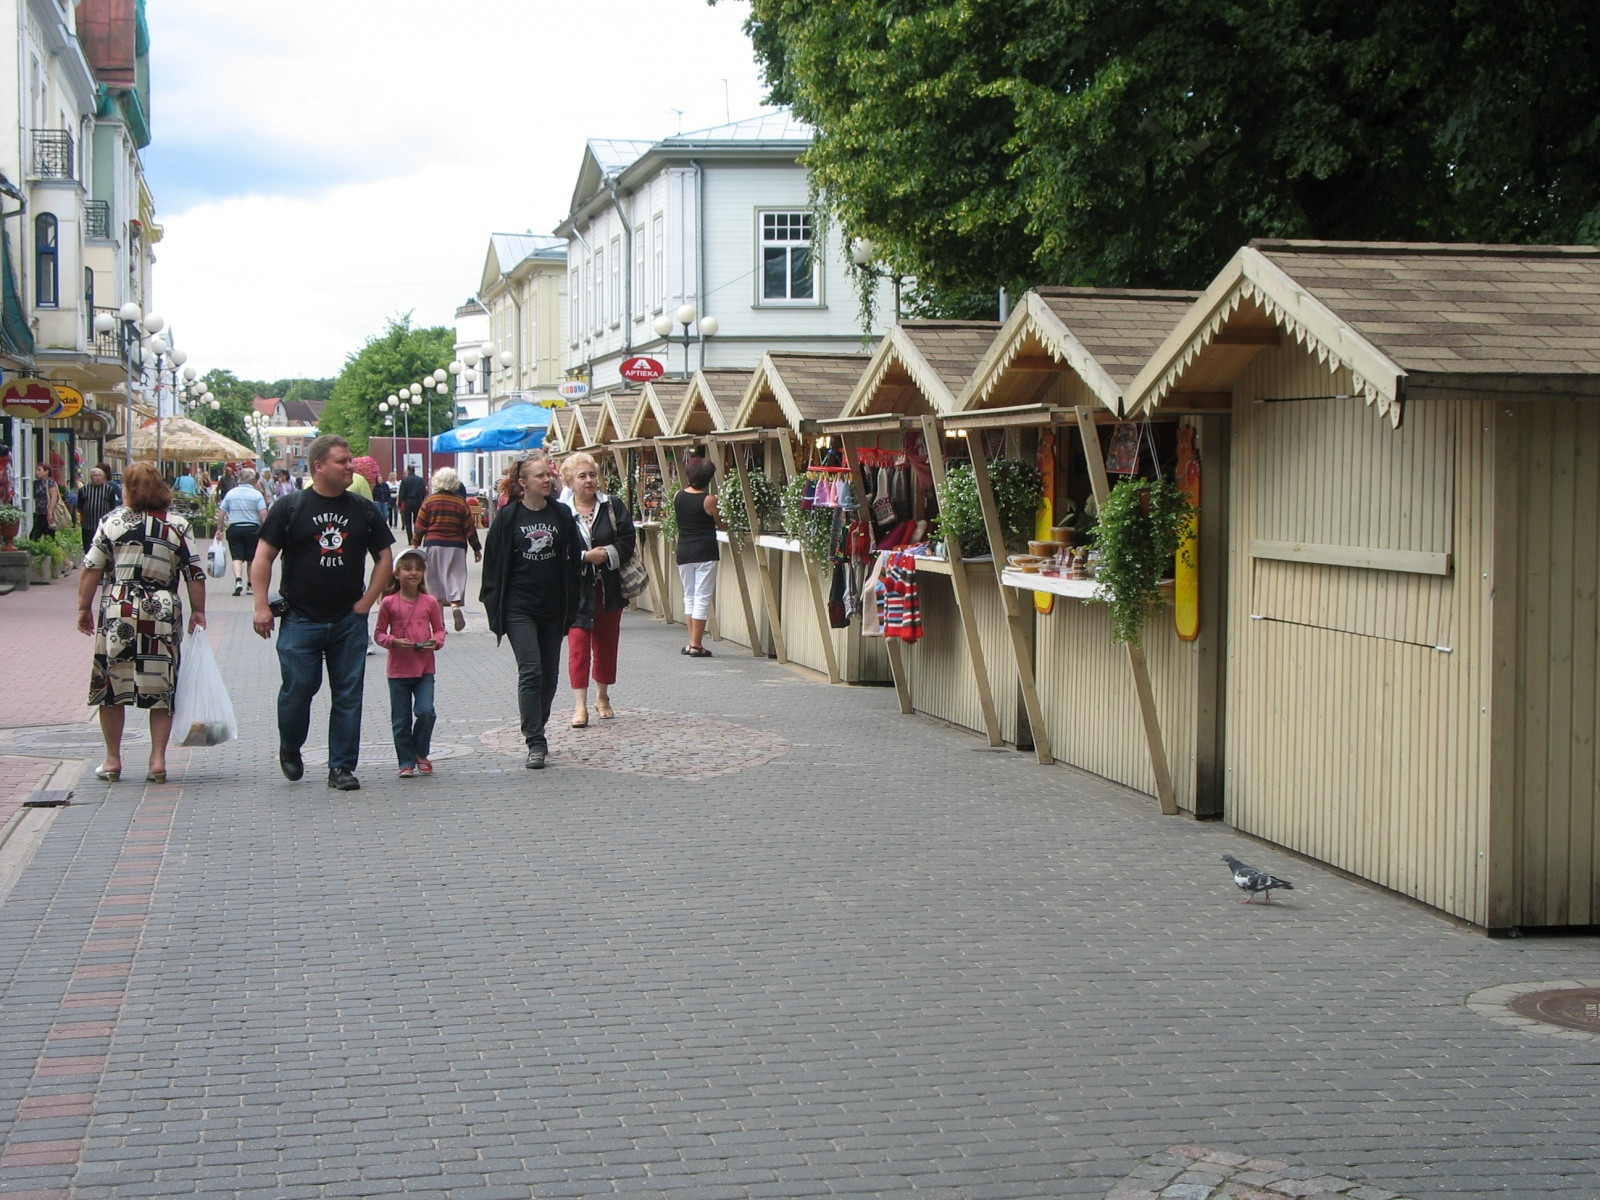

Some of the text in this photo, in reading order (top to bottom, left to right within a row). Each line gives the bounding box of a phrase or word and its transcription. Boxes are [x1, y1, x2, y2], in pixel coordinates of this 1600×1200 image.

[313, 512, 349, 526] PUNTALA
[520, 522, 559, 534] PUNTALA
[319, 555, 344, 567] ROCK
